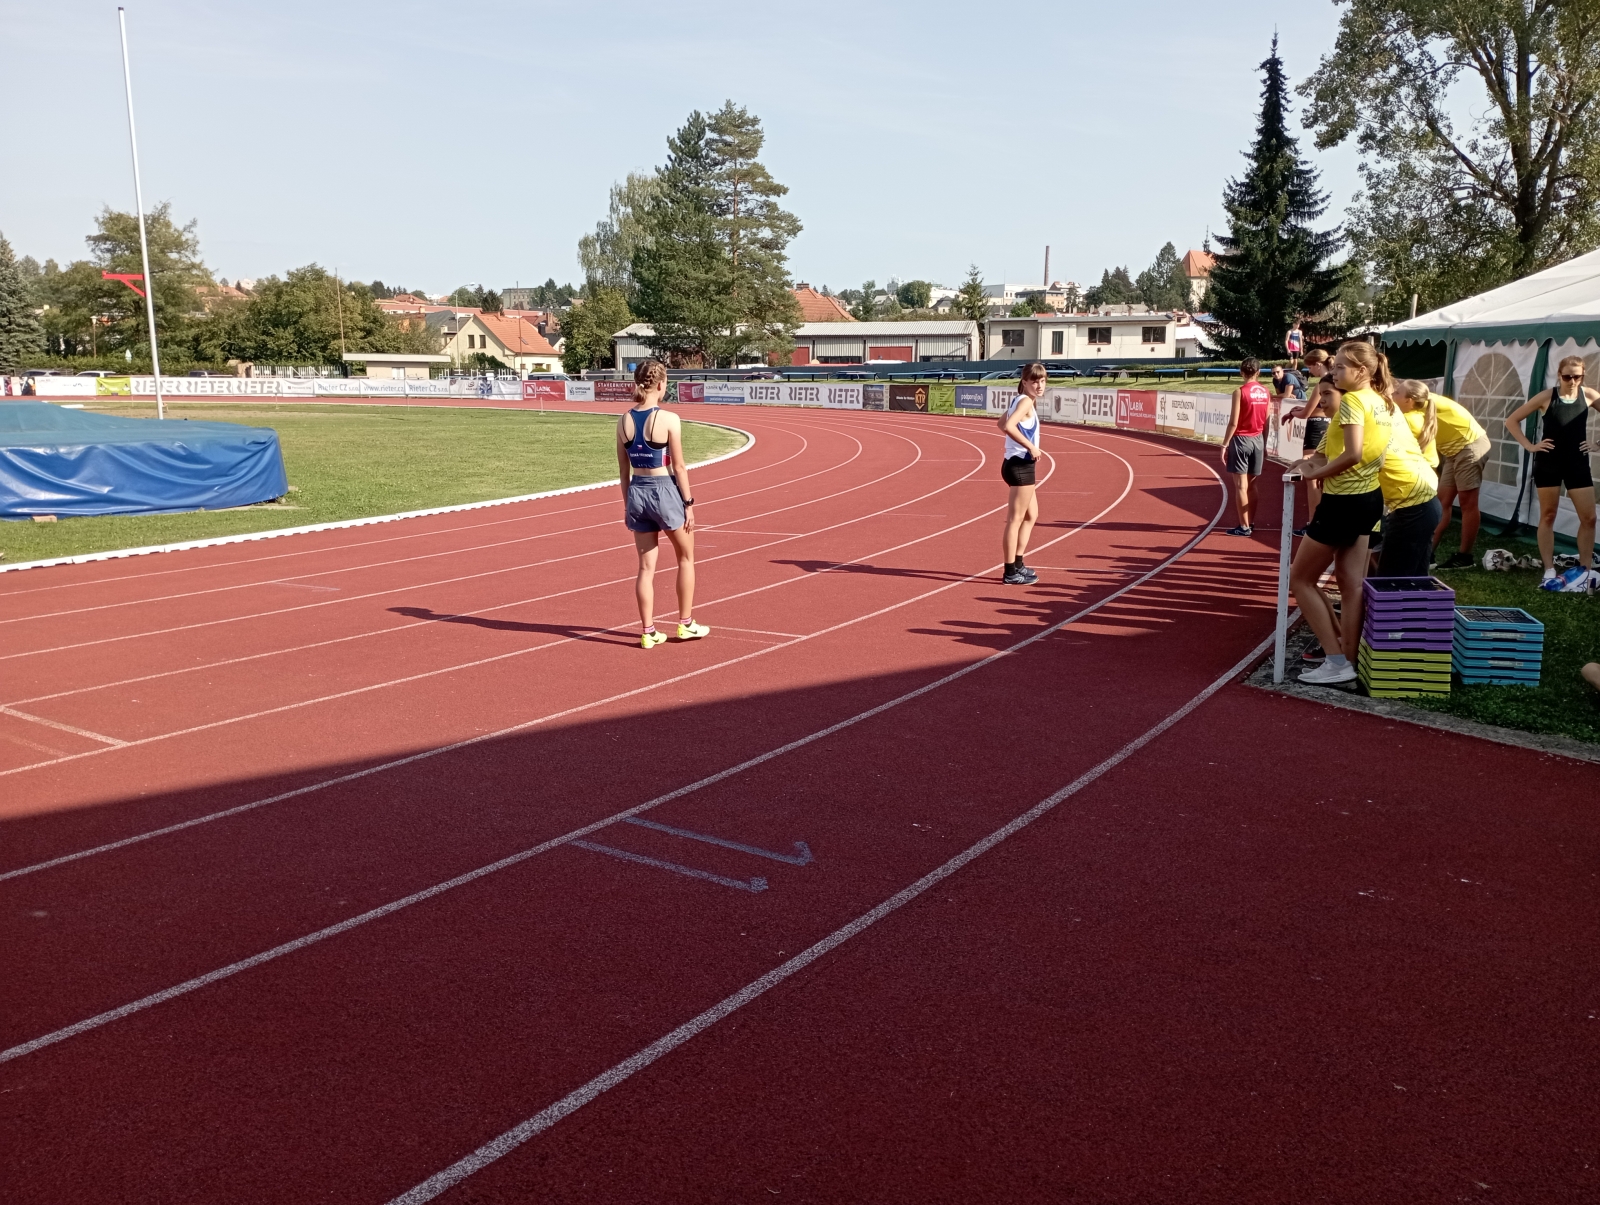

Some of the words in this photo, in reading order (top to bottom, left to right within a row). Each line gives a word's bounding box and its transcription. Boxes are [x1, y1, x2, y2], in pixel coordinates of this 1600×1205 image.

[186, 380, 232, 393] RIETER
[236, 380, 281, 393] RIETER
[339, 384, 348, 392] CZ
[363, 384, 404, 393] www.rieter.cz
[408, 384, 428, 393] Rieter
[429, 384, 437, 393] CZ
[749, 386, 780, 400] RIETER
[788, 386, 820, 401] RIETER
[828, 388, 860, 404] RIETER
[915, 394, 926, 404] KTR
[1082, 393, 1114, 417] RIETER
[1130, 400, 1144, 412] LABÍK
